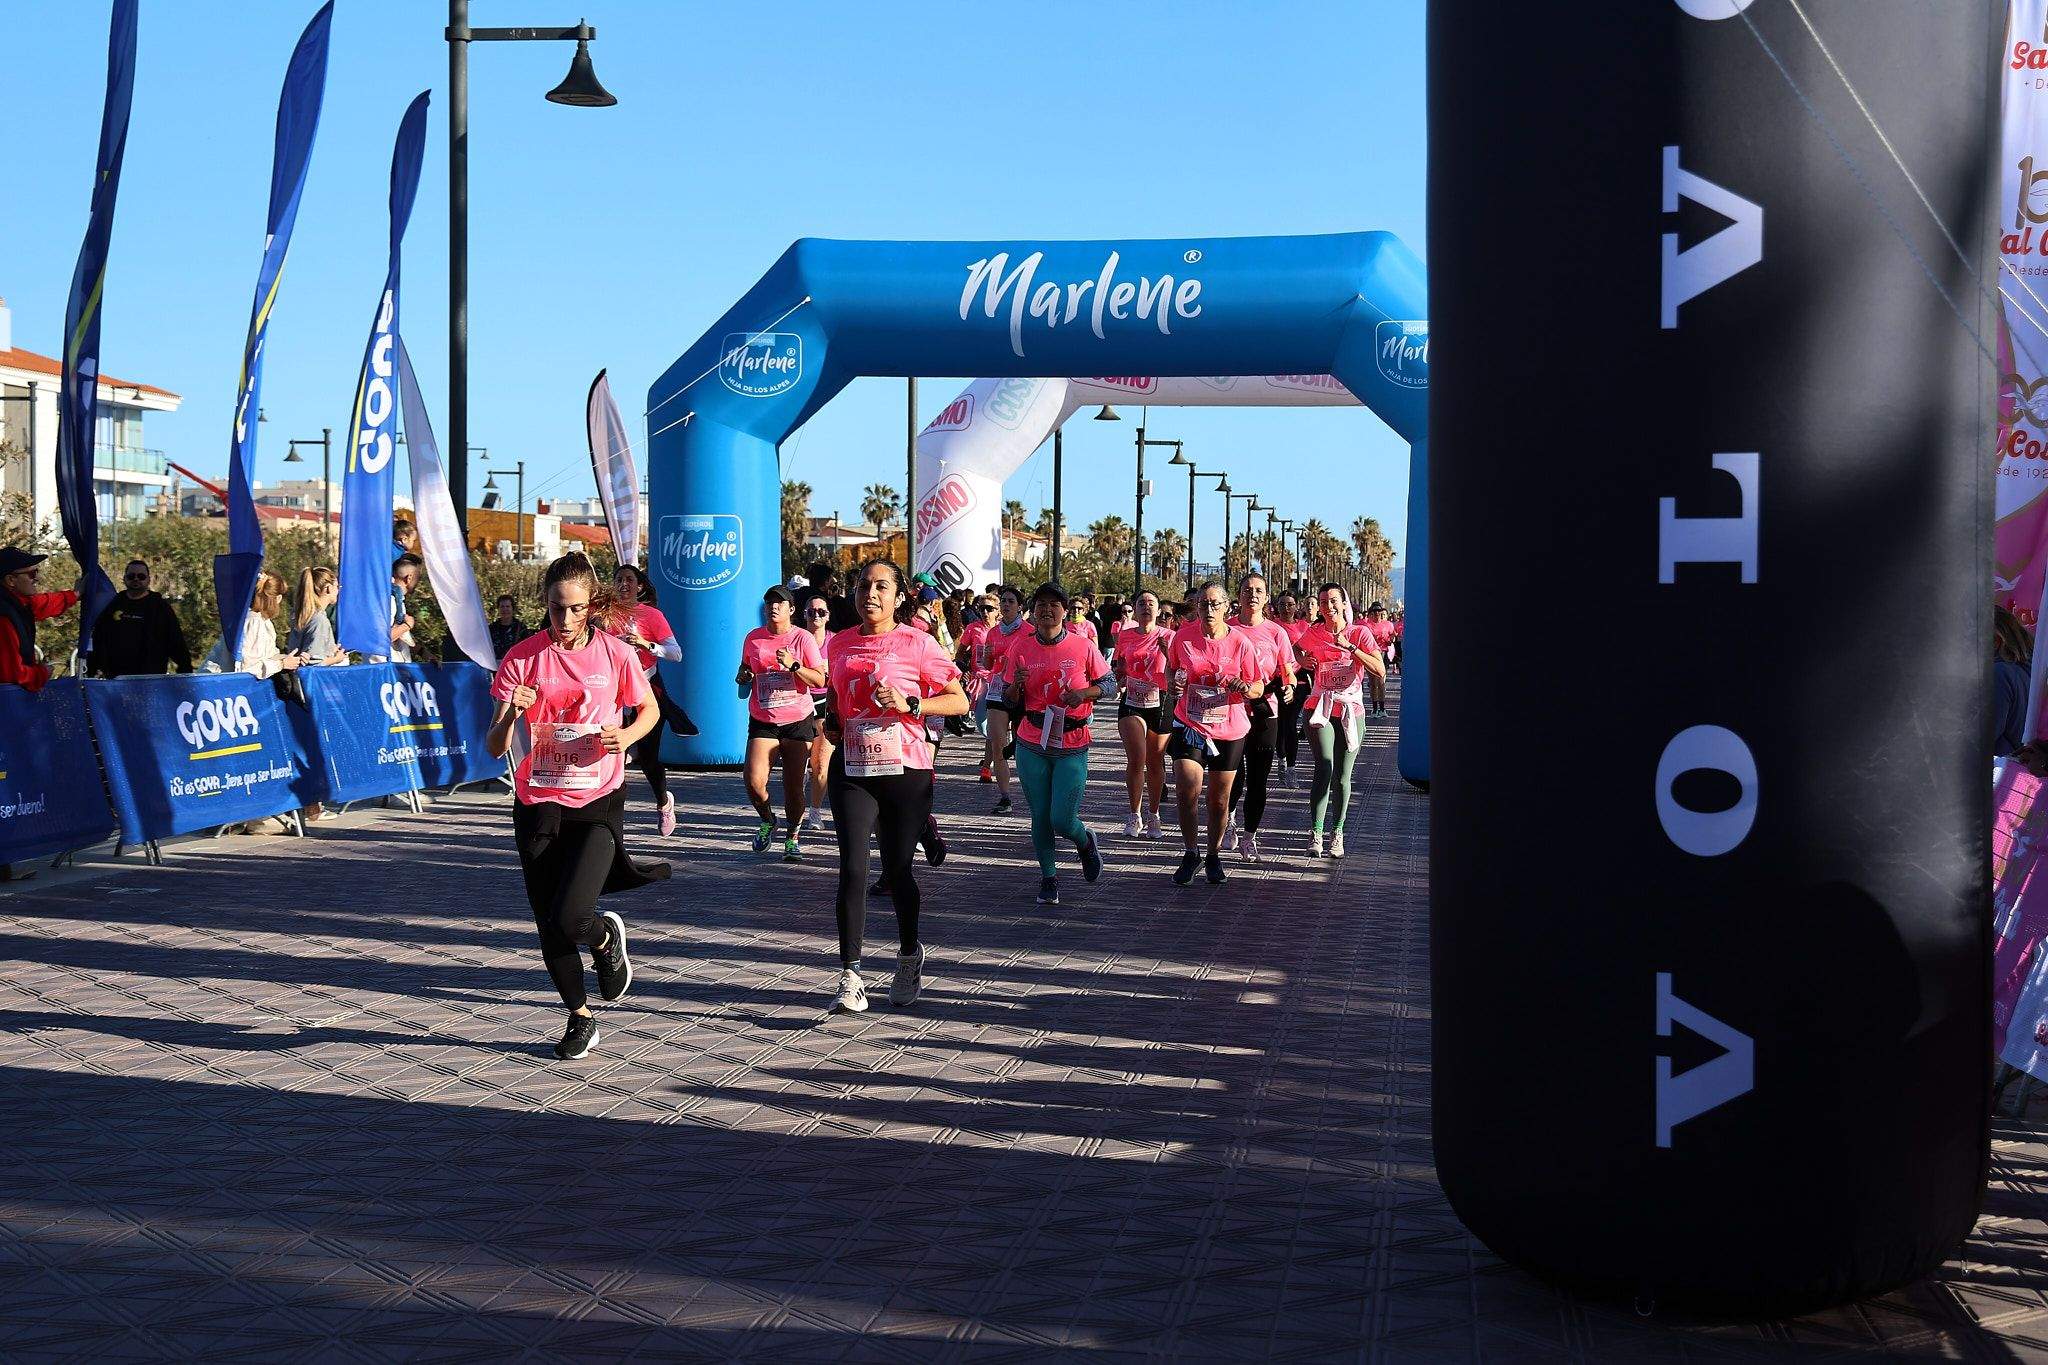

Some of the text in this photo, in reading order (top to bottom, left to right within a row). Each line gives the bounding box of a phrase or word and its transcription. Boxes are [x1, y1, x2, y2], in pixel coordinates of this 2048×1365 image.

[2000, 227, 2032, 255] al
[959, 251, 1202, 357] Marlene
[724, 346, 796, 379] Marlene
[1383, 336, 1429, 370] Marl
[727, 377, 742, 389] HIJA
[770, 379, 790, 391] ALPES
[1387, 369, 1401, 380] HIJA
[1403, 376, 1412, 384] DE
[663, 531, 737, 569] Marlene
[666, 568, 679, 580] HIJA
[681, 576, 690, 584] DE
[708, 569, 731, 583] ALPES
[1656, 0, 1764, 1148] VOLV
[381, 682, 440, 723] GOYA
[176, 695, 259, 749] GOYA
[554, 753, 580, 763] 016
[859, 744, 882, 753] 016
